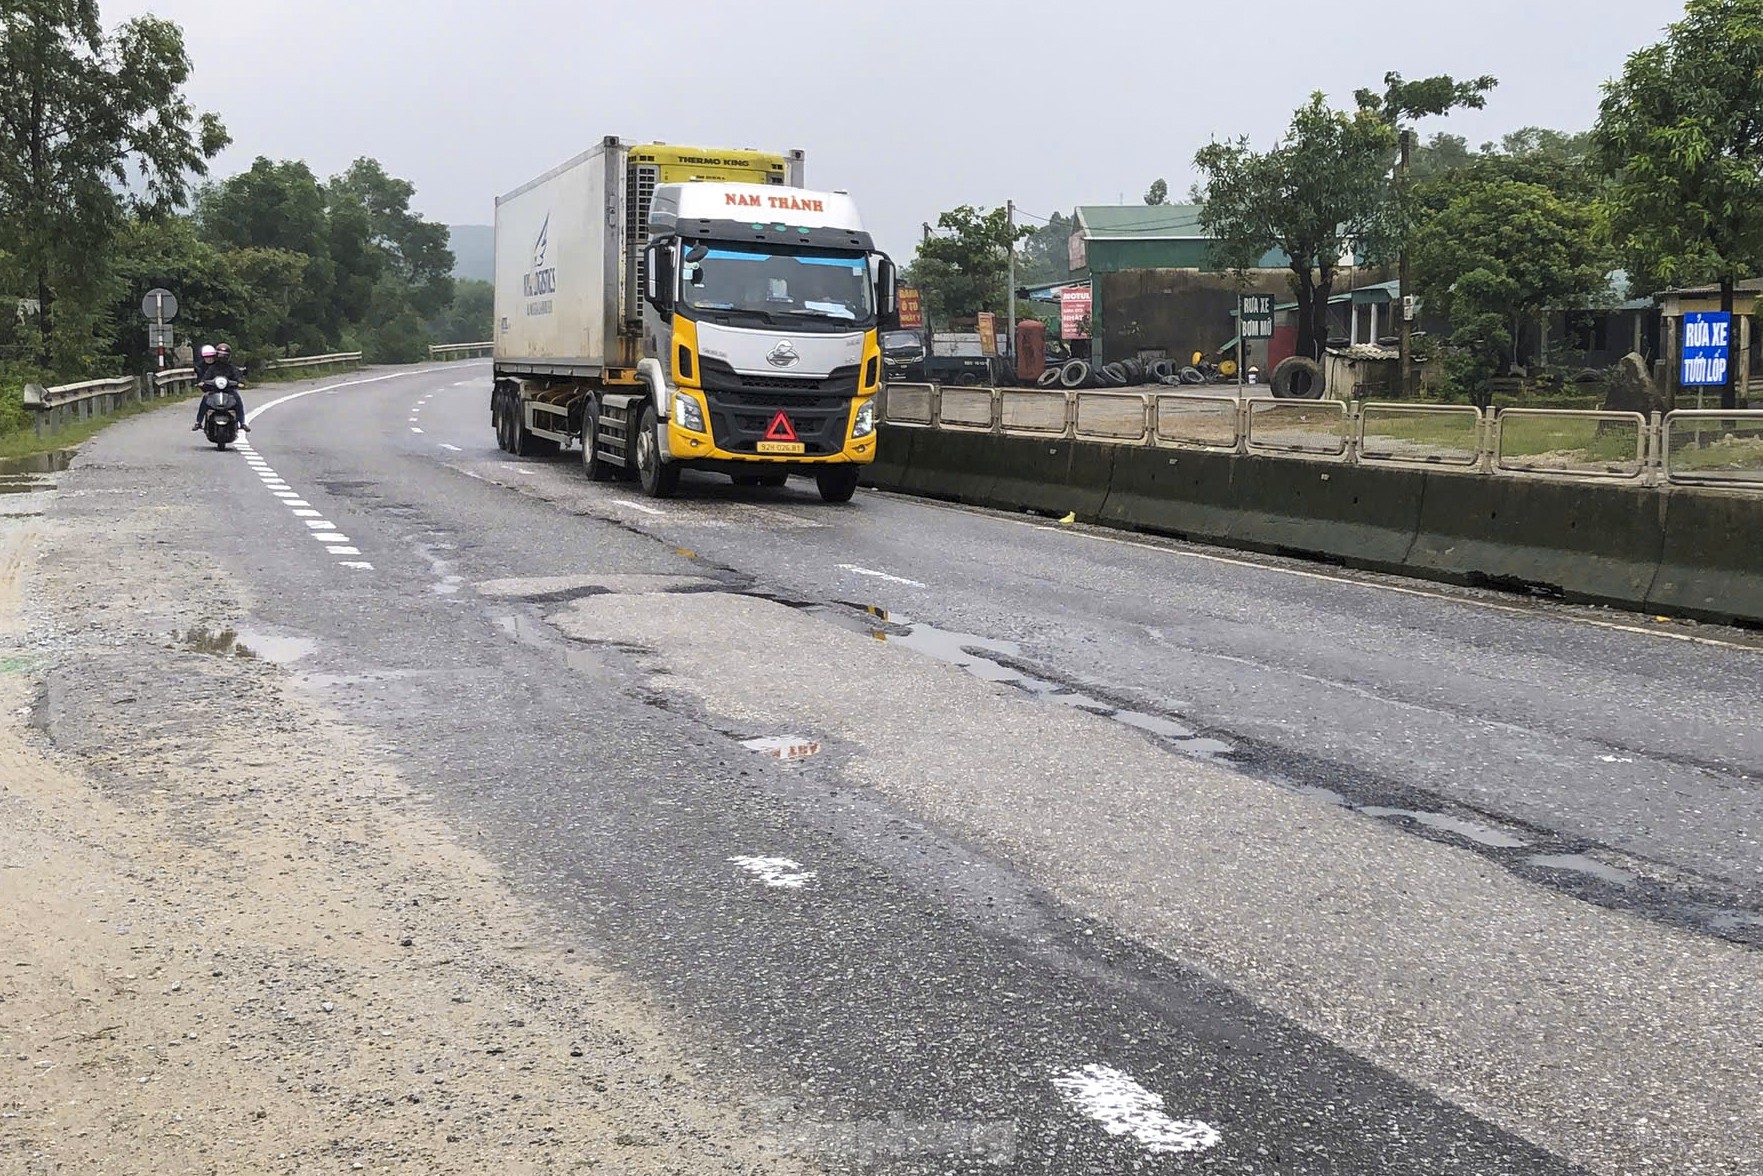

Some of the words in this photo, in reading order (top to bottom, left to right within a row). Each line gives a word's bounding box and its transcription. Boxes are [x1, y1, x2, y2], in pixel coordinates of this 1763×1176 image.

[678, 156, 721, 165] THERMO
[723, 159, 750, 167] KING
[725, 193, 761, 207] NAM
[767, 195, 824, 212] THÀNH
[1260, 298, 1270, 313] XE
[1242, 319, 1259, 336] BƠM
[1685, 313, 1710, 347] RỬA
[1711, 322, 1728, 346] XE
[1684, 351, 1706, 383] TƯỚI
[1706, 349, 1727, 382] LỐP
